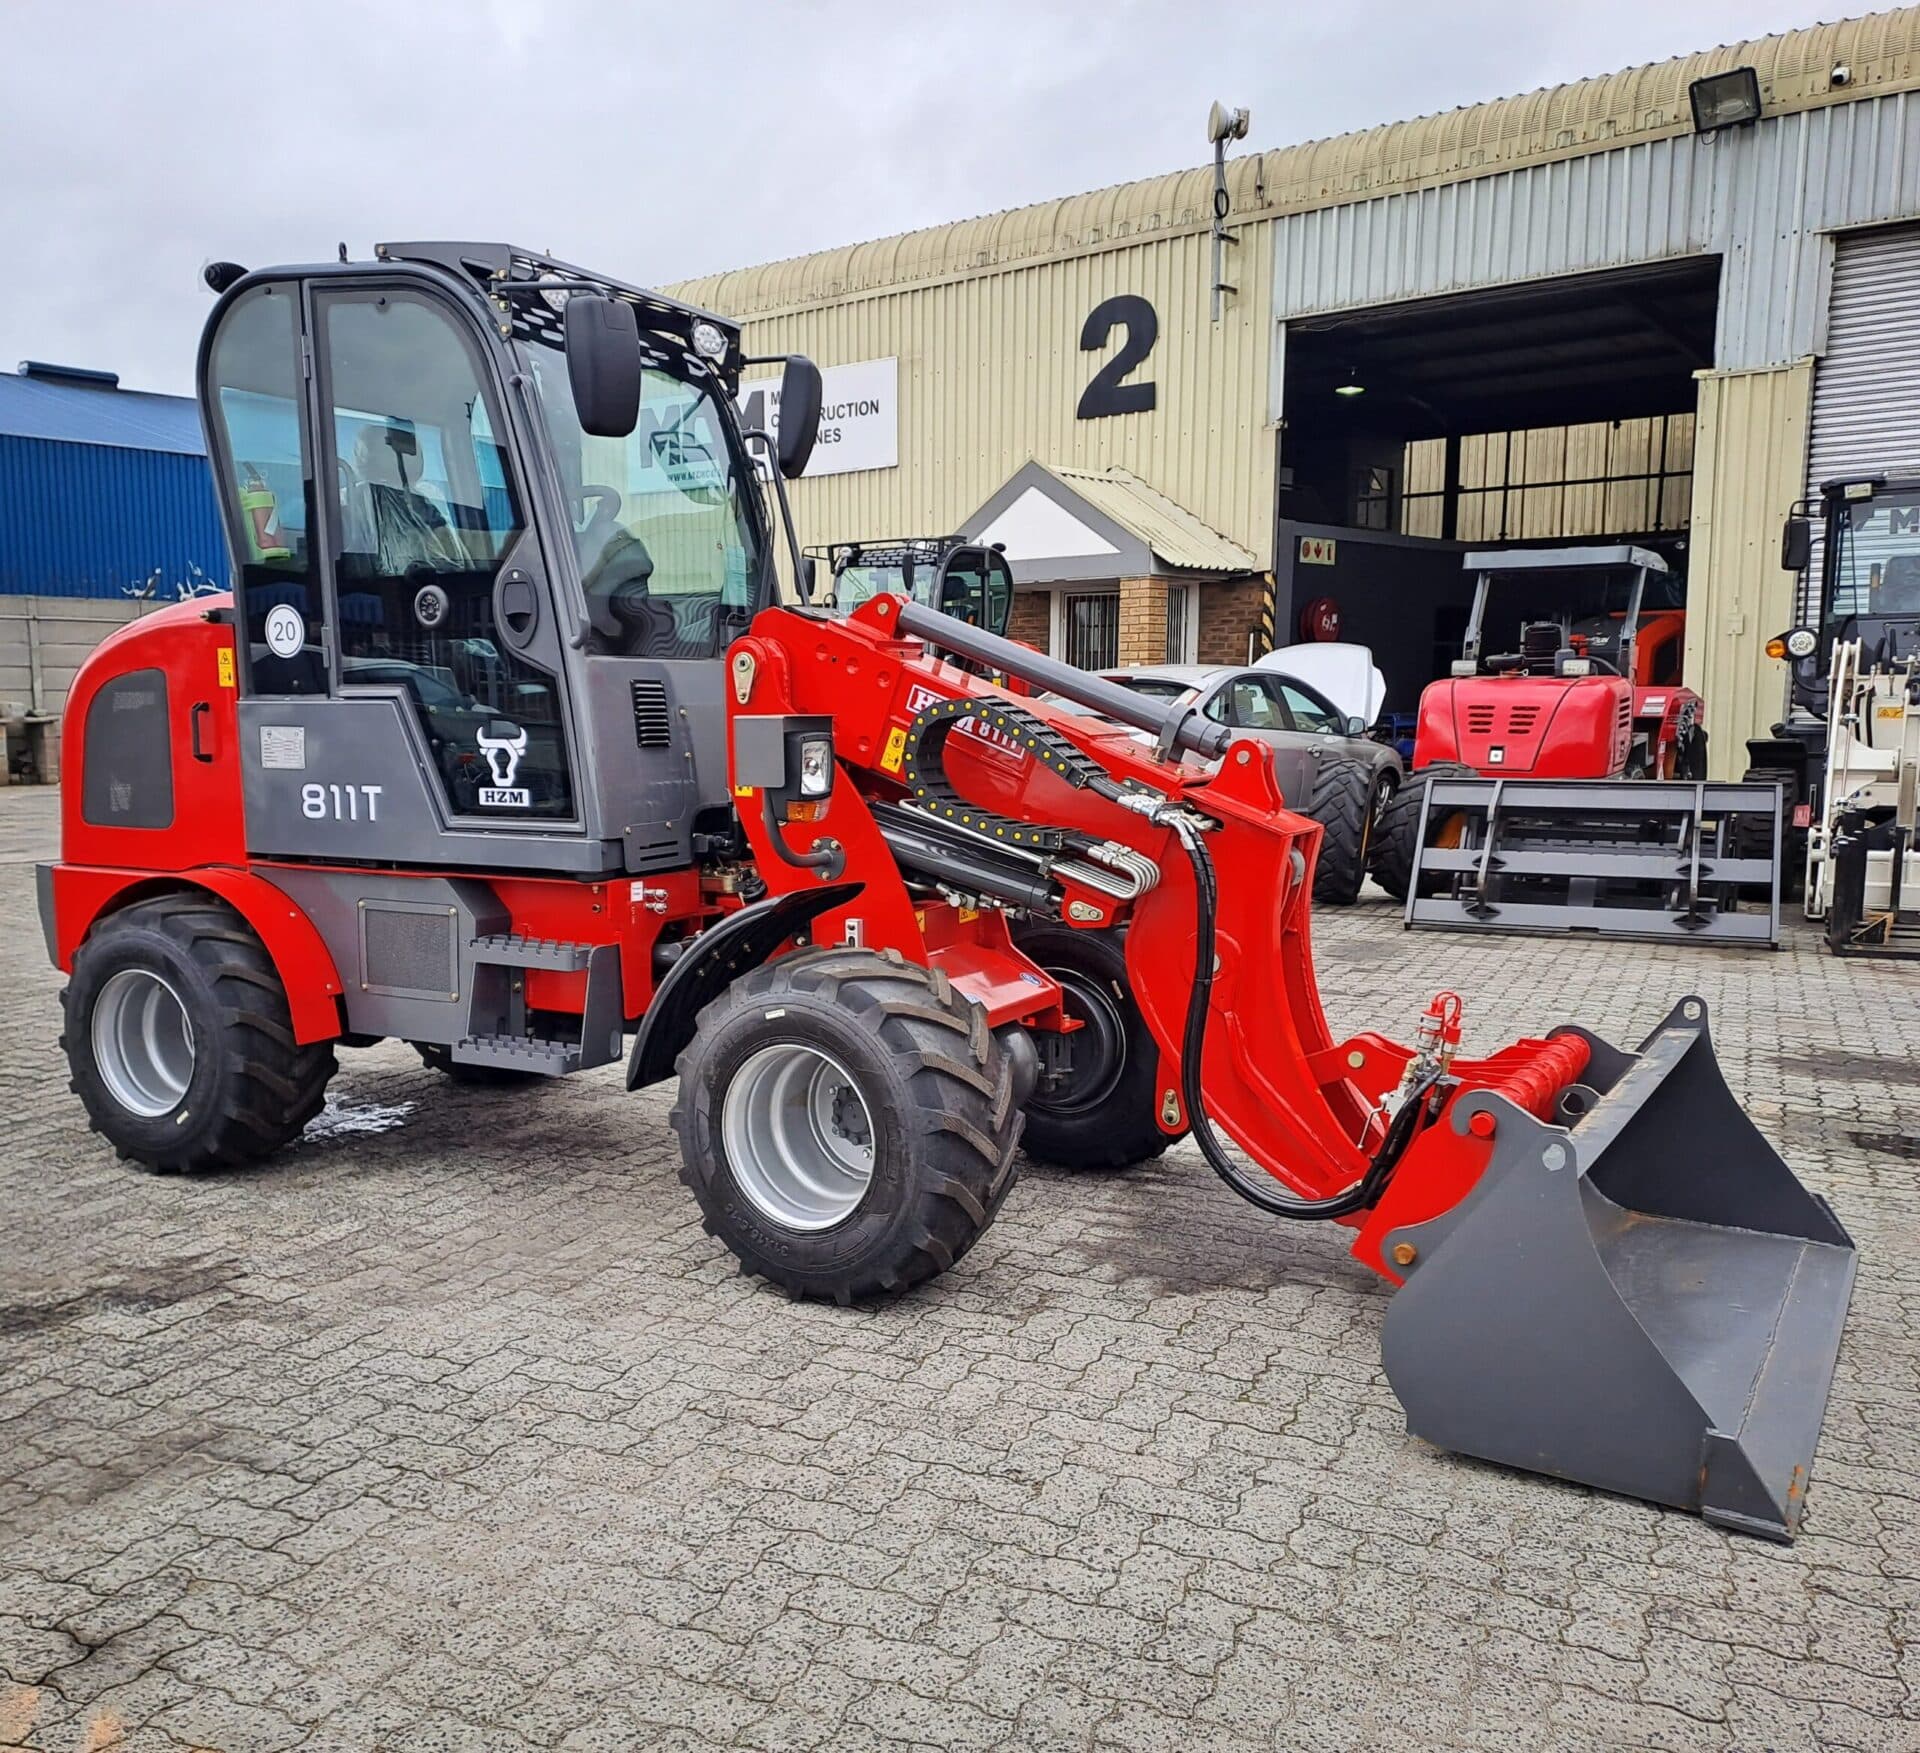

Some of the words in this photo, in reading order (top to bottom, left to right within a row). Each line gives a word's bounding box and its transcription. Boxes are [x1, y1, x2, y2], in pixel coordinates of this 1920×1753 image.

[1077, 294, 1158, 420] 2
[273, 621, 296, 642] 20
[301, 783, 383, 822] 811T
[483, 790, 525, 804] HZM
